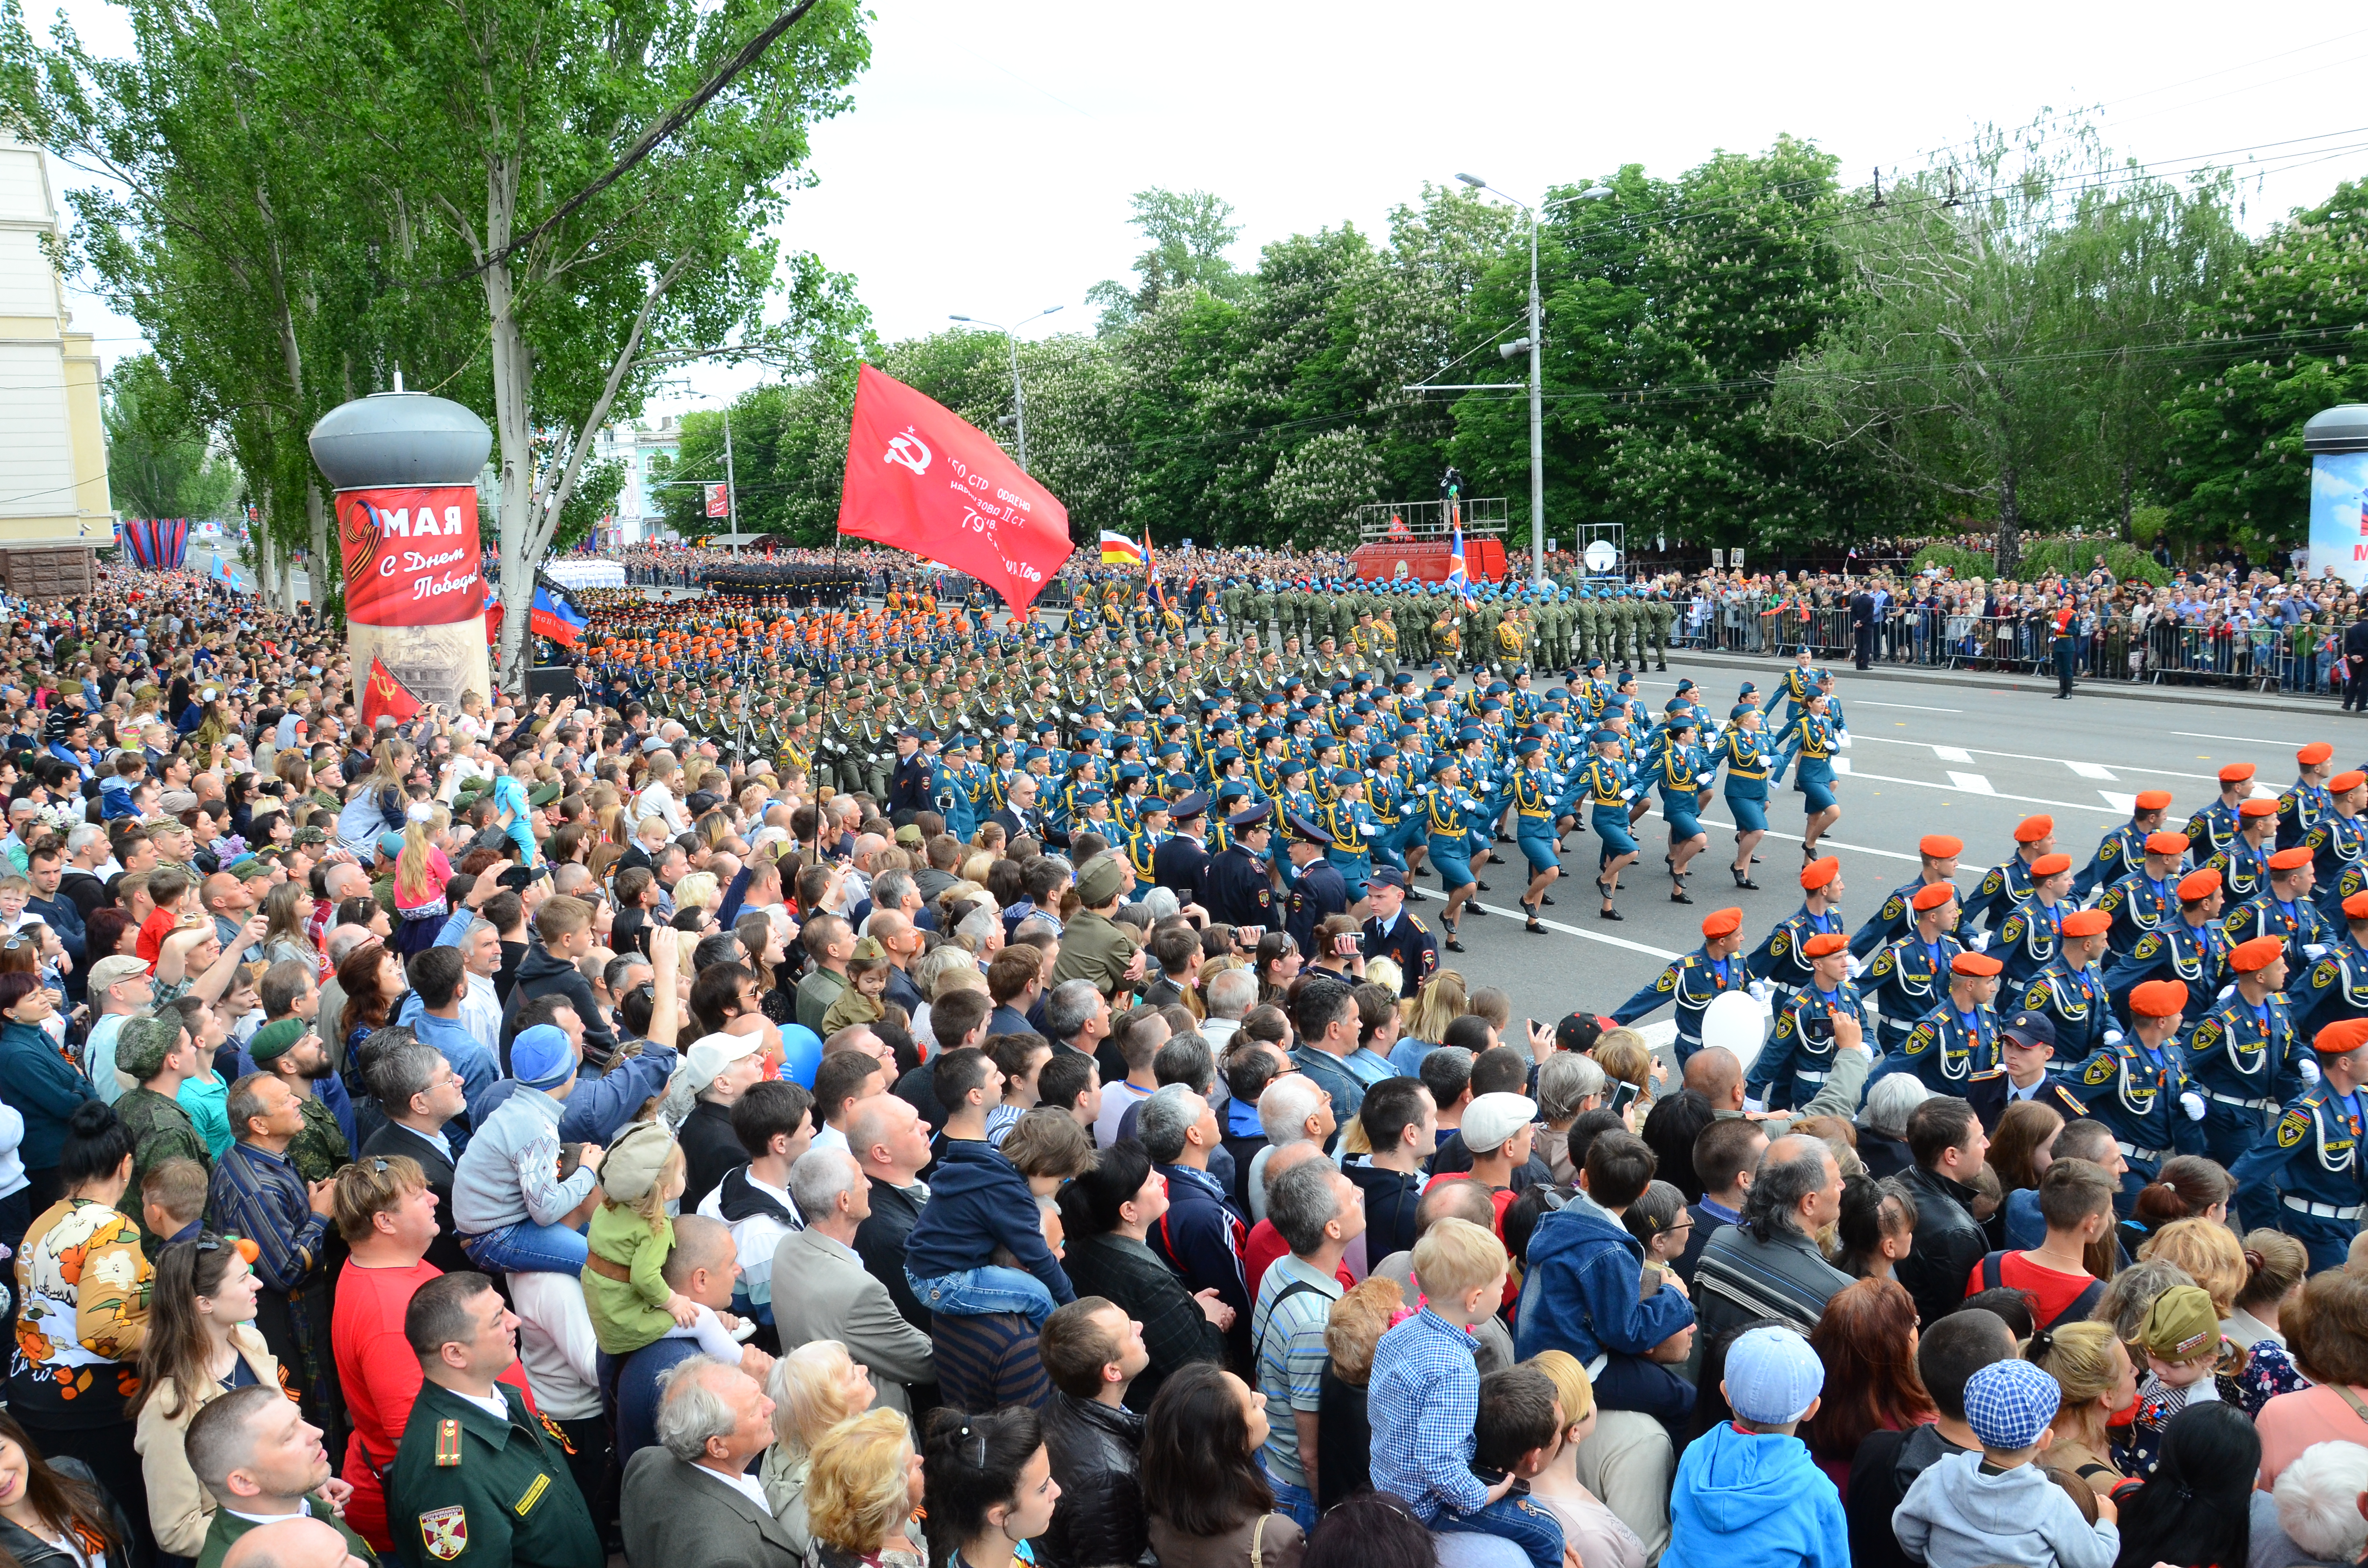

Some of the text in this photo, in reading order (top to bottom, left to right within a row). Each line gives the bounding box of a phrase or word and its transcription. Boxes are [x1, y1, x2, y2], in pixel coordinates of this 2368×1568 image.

[998, 488, 1030, 512] ОРДЕНА
[380, 506, 462, 538] МАЯ
[962, 506, 984, 532] 79
[380, 548, 464, 576] С Днем
[413, 563, 478, 600] Победы!
